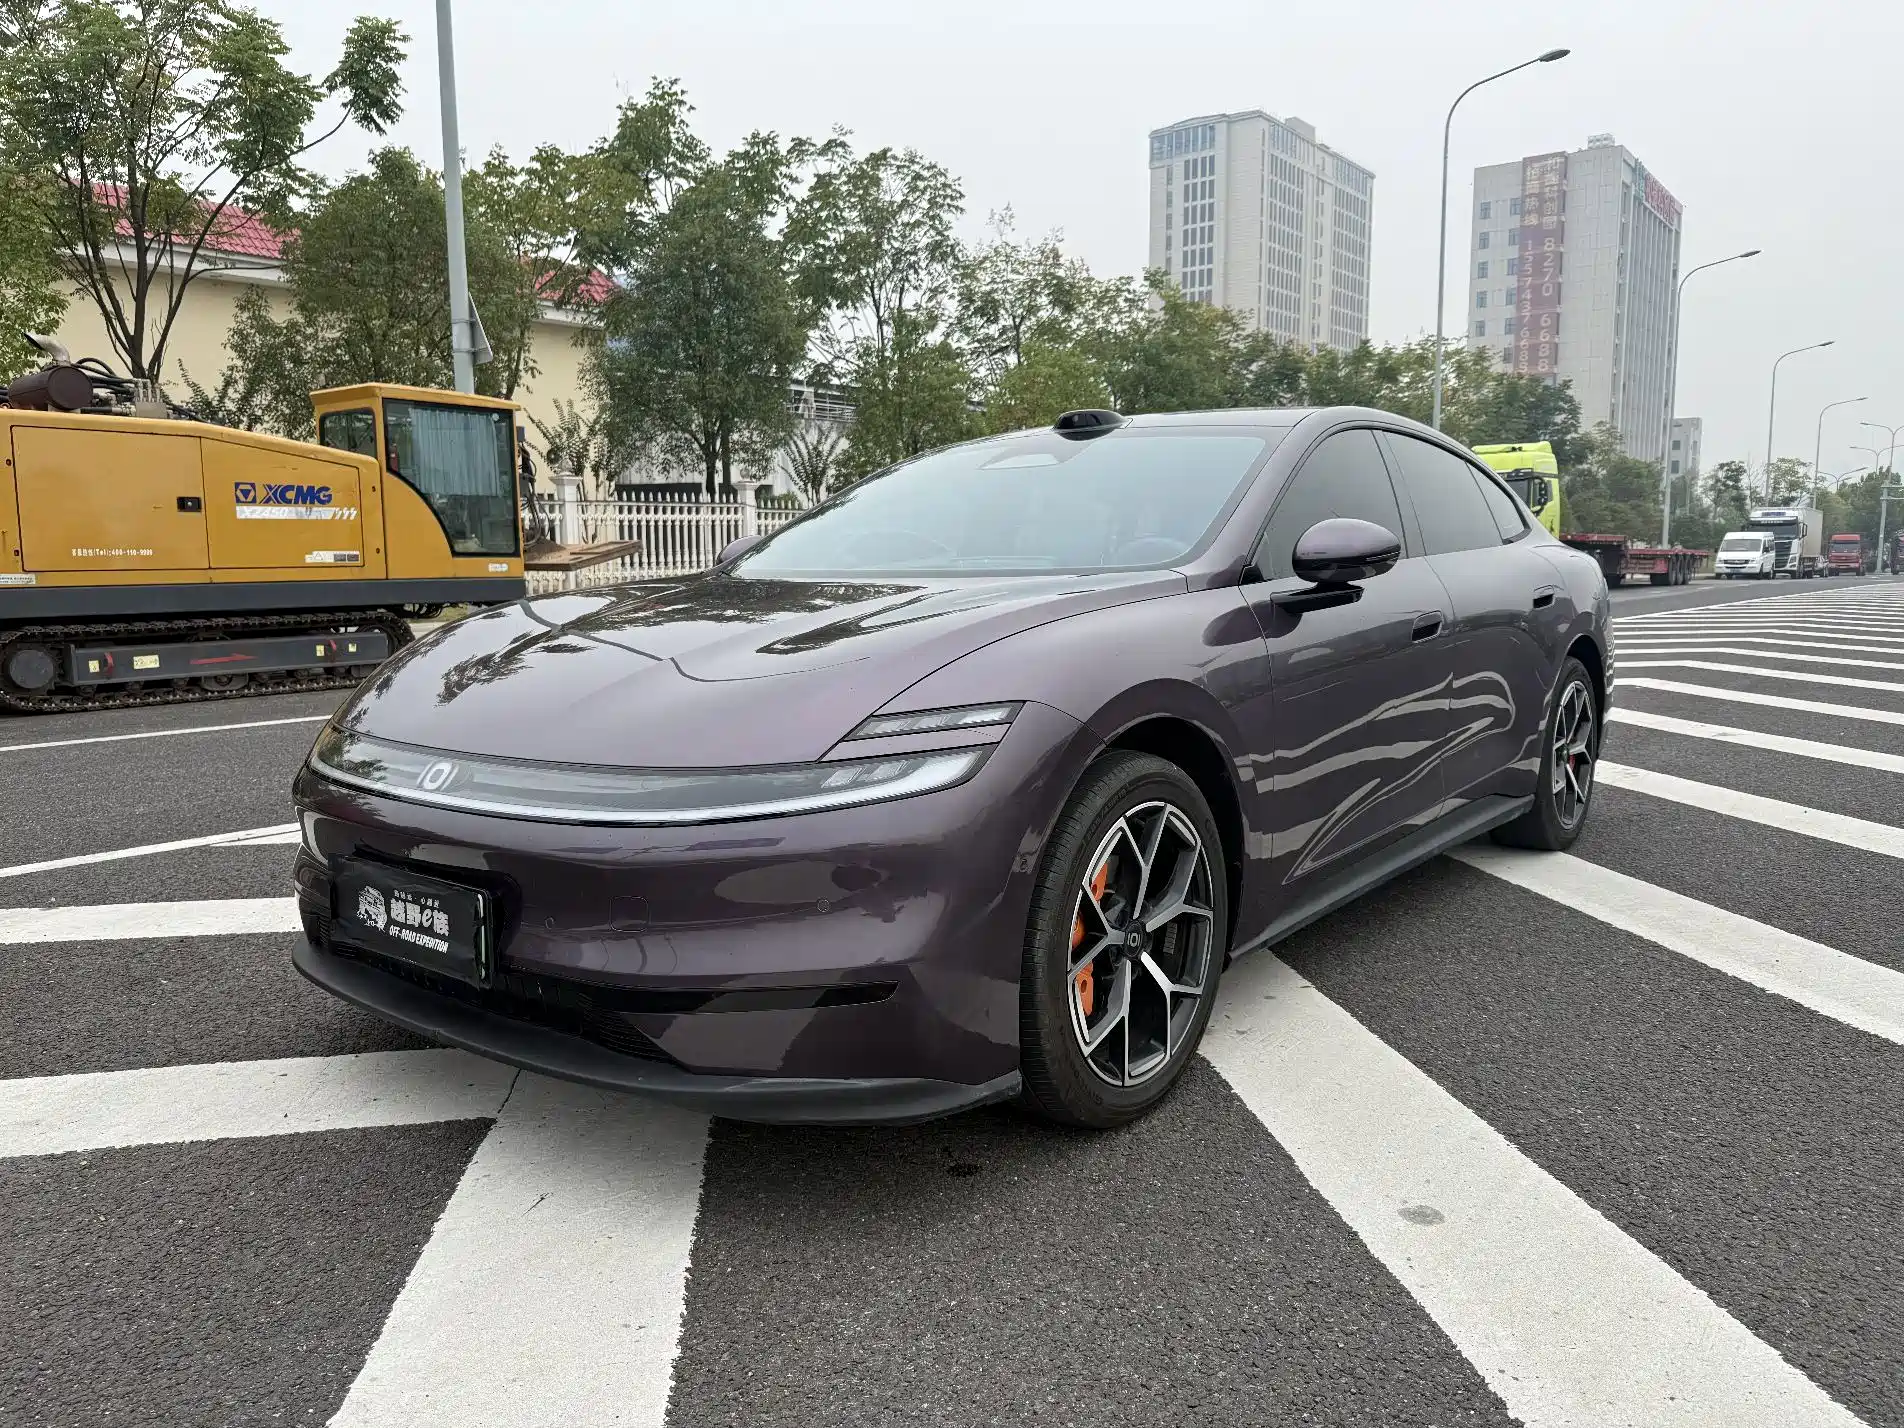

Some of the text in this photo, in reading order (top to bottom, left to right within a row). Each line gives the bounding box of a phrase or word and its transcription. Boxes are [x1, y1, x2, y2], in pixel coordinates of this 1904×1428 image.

[1542, 237, 1555, 296] 8270
[1538, 314, 1551, 372] 6688
[260, 483, 333, 505] XCMG
[390, 898, 449, 936] 越野e族
[389, 925, 449, 953] OFF-ROAD EXPEDITION
